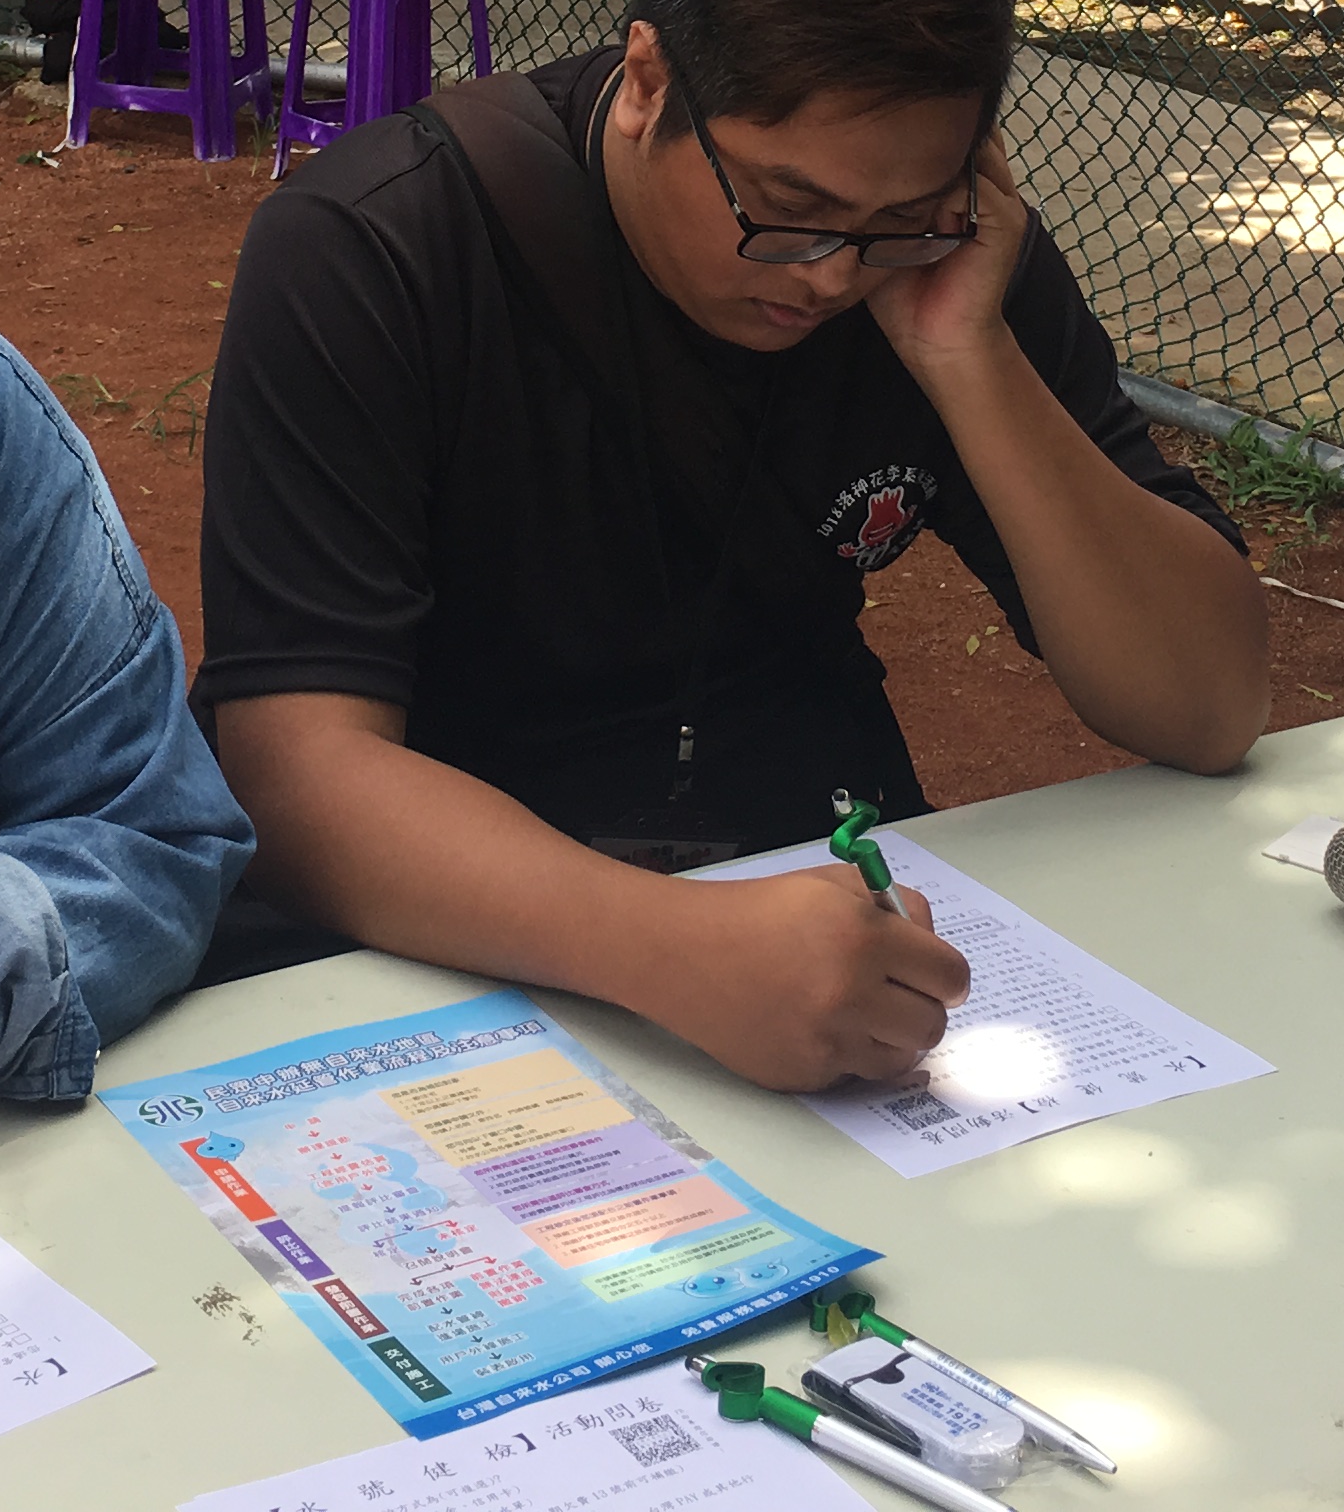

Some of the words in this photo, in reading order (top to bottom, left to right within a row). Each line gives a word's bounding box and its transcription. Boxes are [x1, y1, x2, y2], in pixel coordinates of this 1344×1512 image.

[383, 1347, 435, 1391] 交付施工
[456, 1364, 592, 1421] 台灣自來水公司
